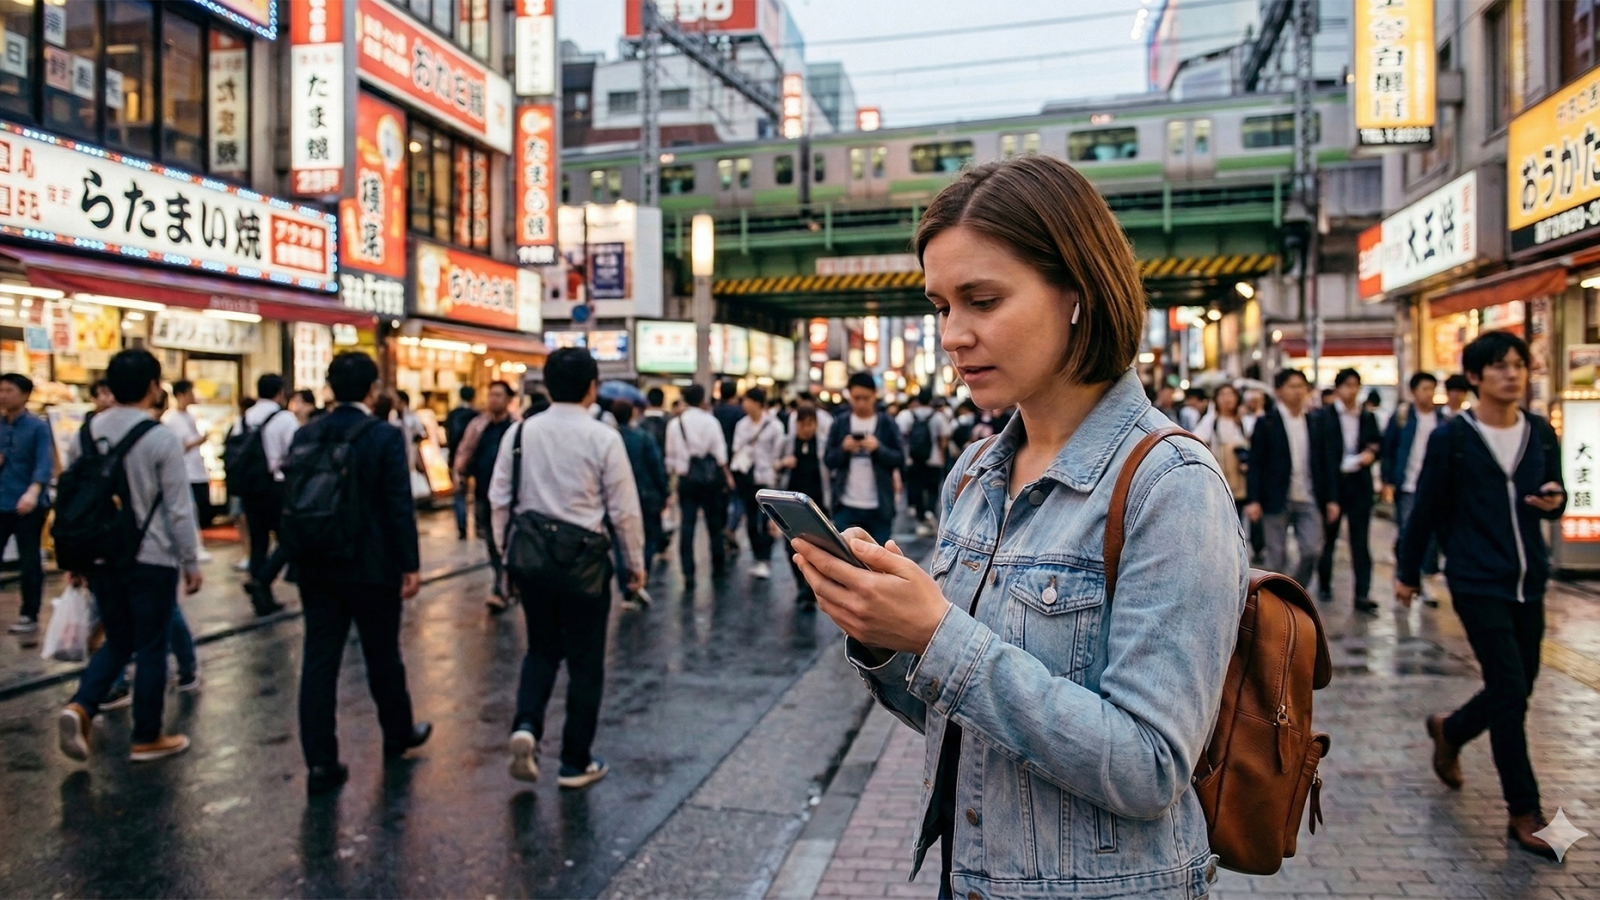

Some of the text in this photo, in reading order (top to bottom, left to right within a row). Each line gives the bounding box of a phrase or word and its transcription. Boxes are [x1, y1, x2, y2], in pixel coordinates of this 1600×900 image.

[81, 169, 263, 260] らたまい焼
